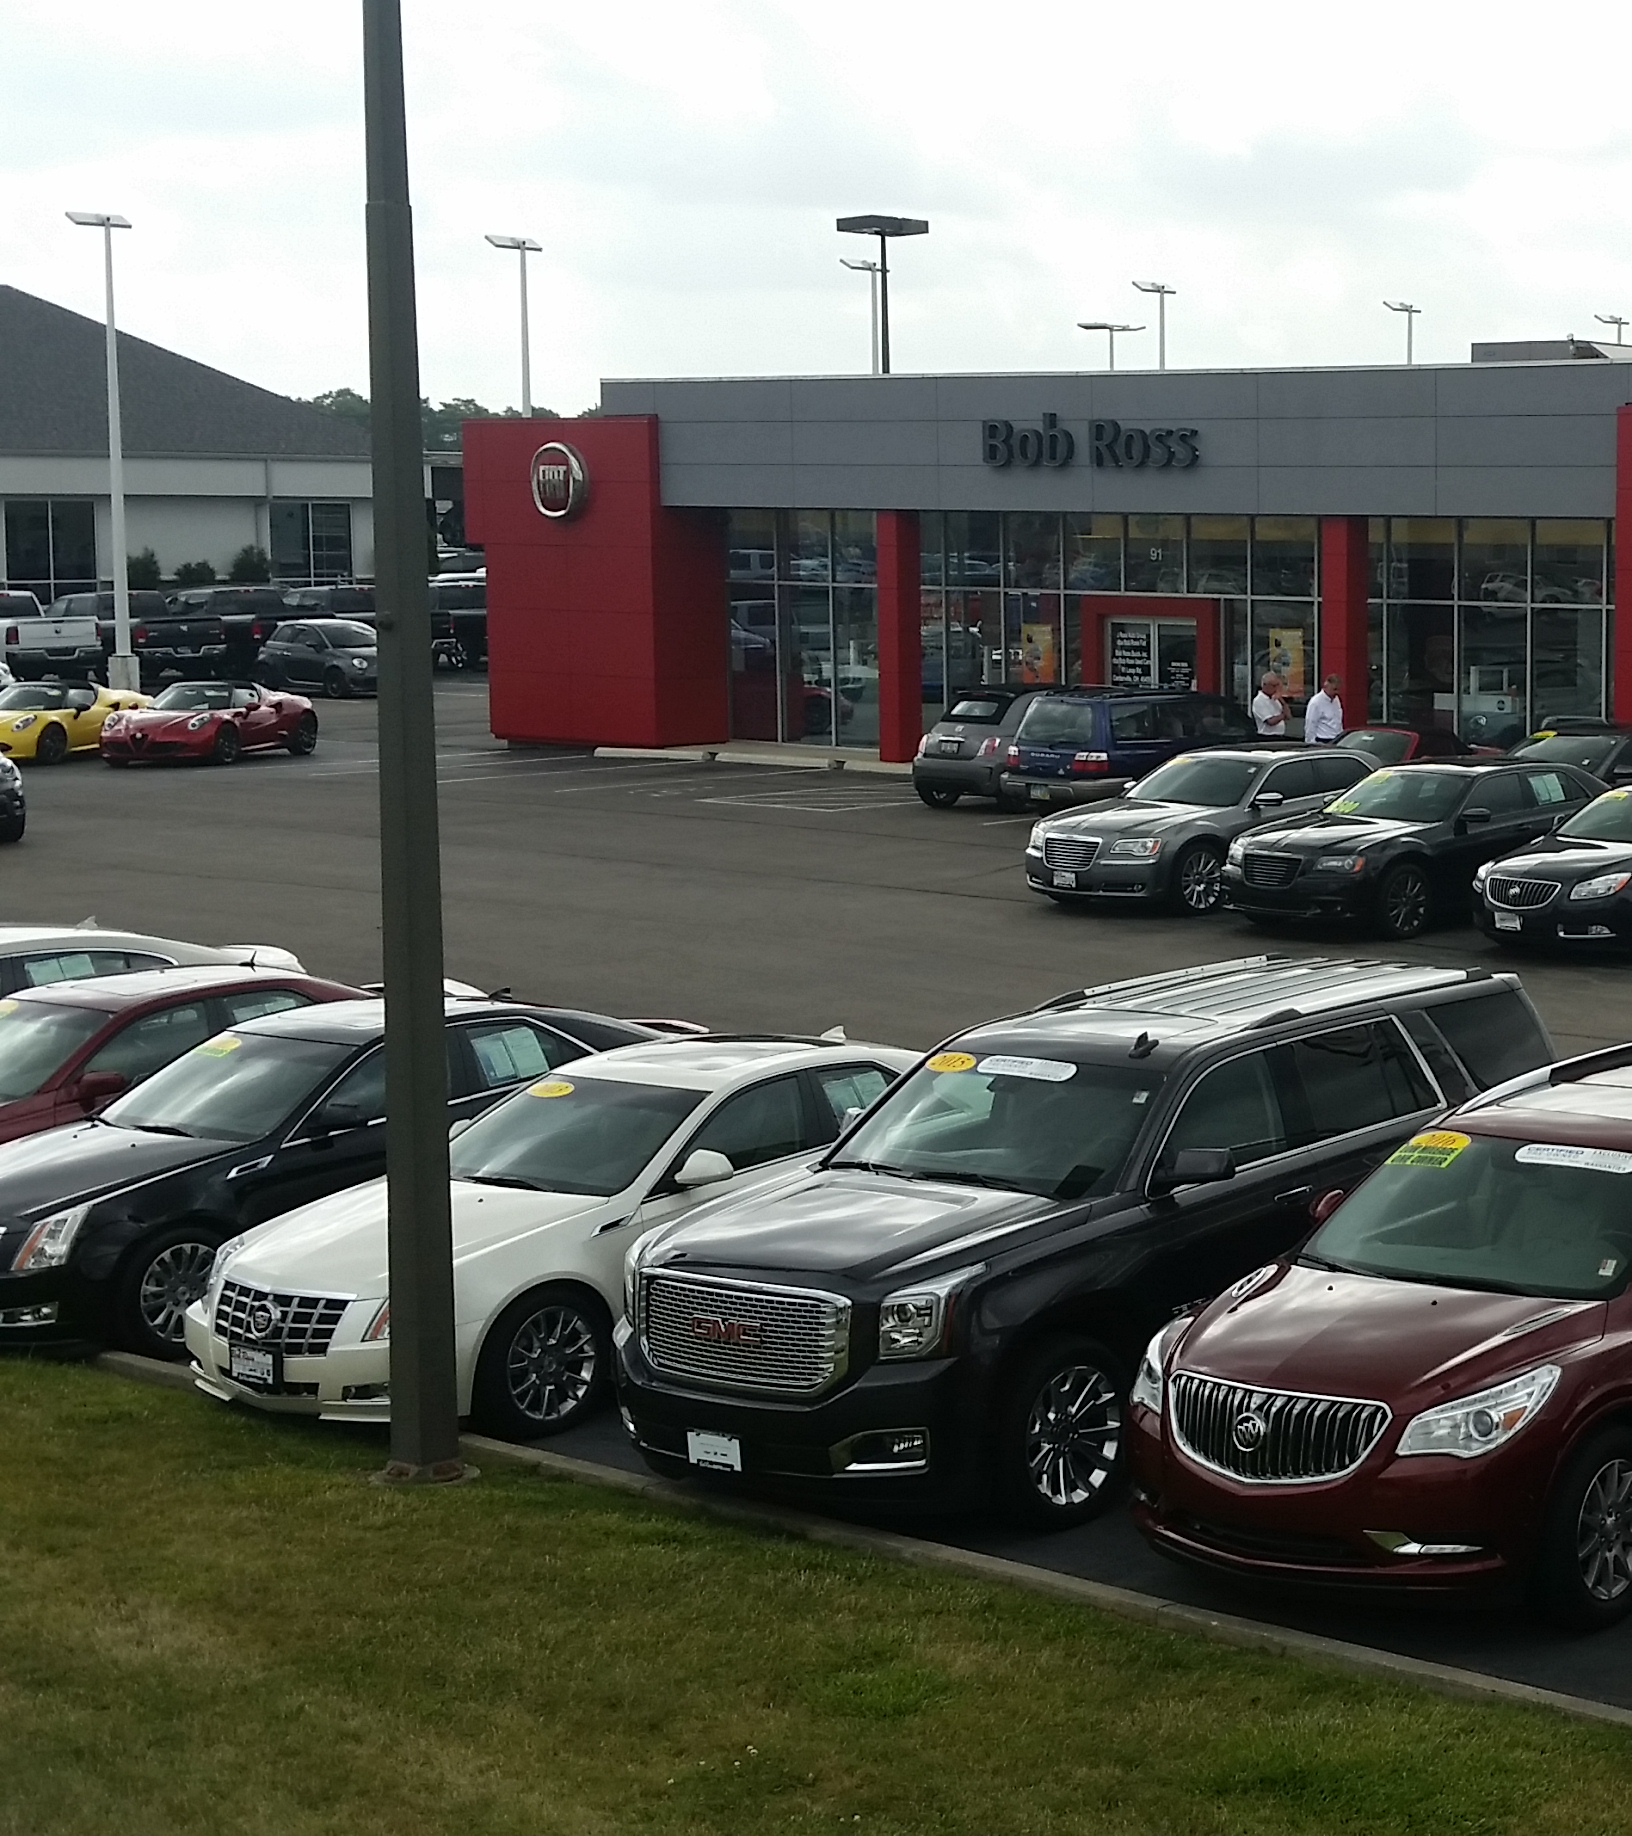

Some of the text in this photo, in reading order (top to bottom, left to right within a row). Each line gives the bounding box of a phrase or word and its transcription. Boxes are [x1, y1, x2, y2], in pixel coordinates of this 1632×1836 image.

[981, 412, 1200, 467] Bob Ross
[1150, 548, 1162, 561] 91
[1527, 1146, 1585, 1155] CERTIFIED
[691, 1314, 761, 1344] GMC
